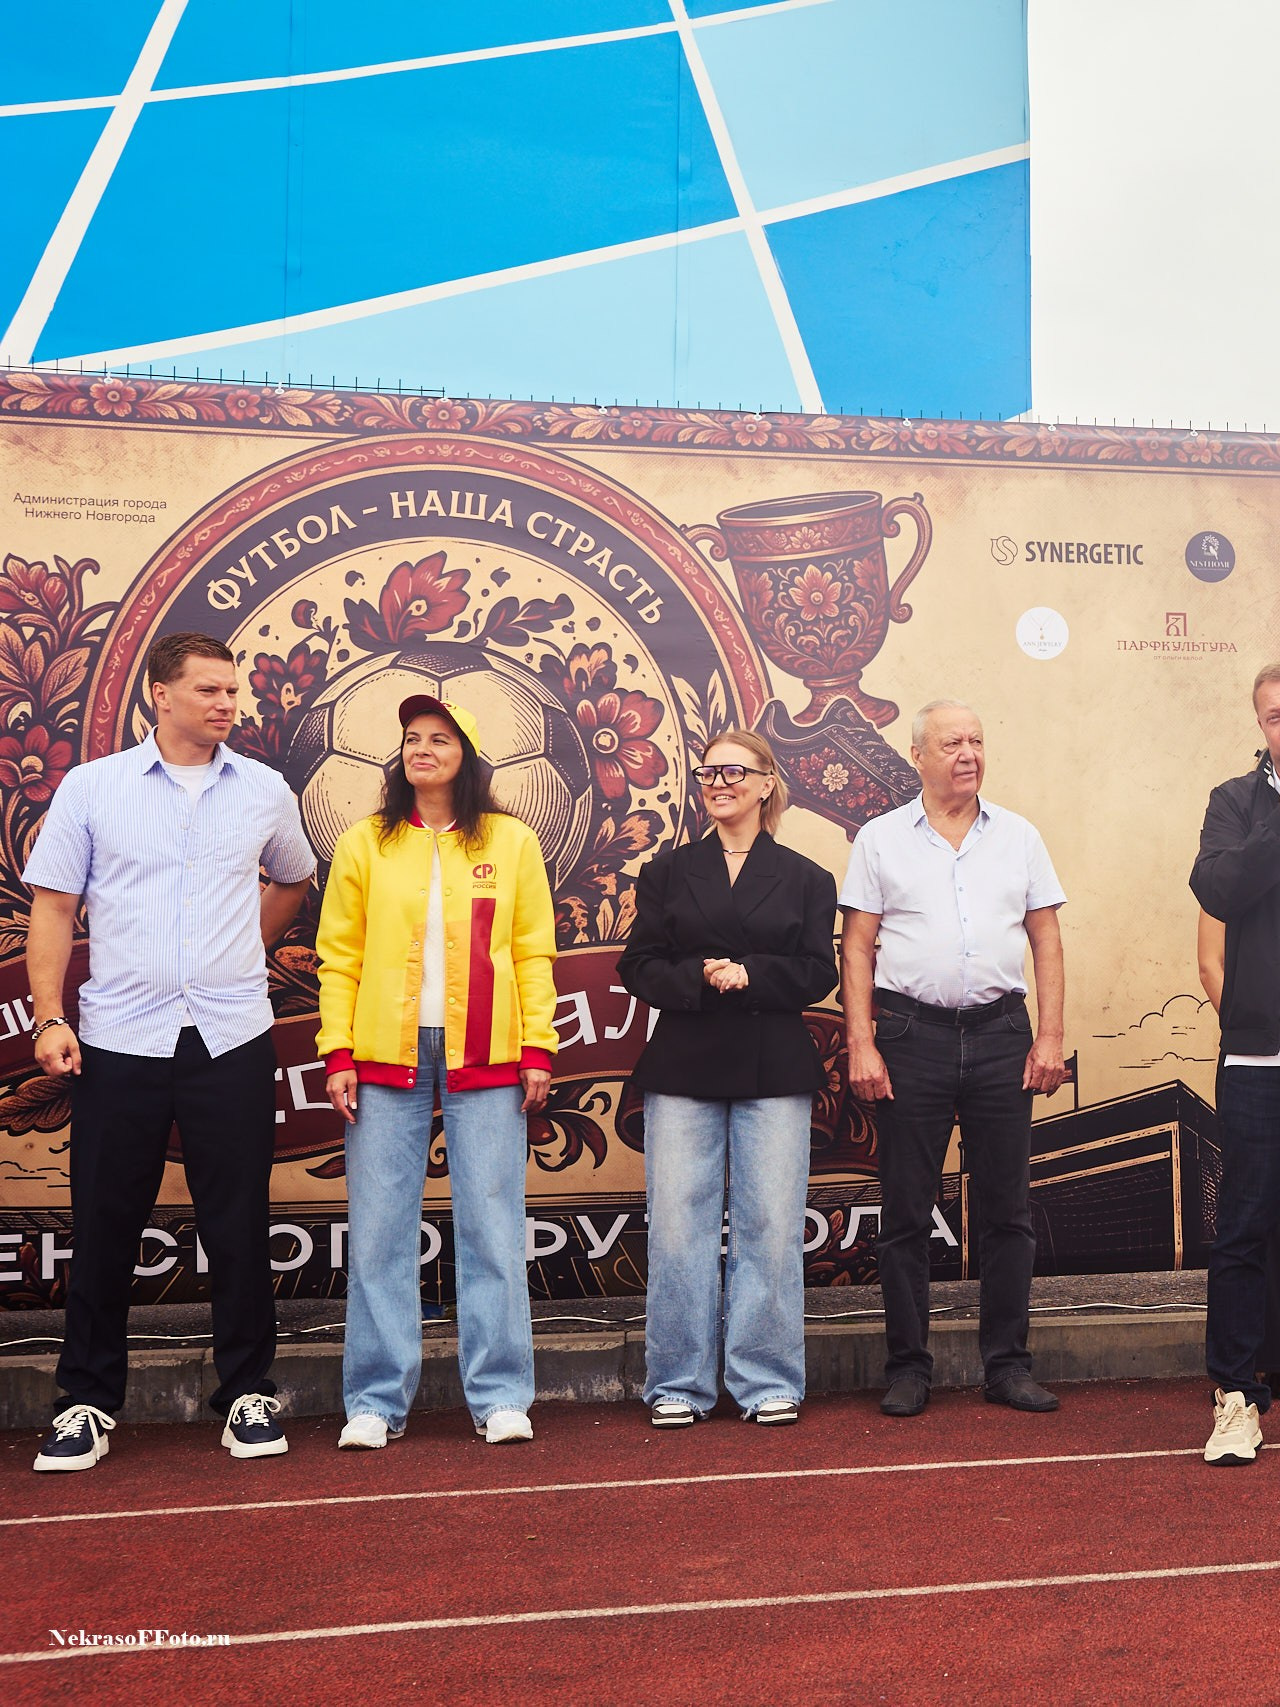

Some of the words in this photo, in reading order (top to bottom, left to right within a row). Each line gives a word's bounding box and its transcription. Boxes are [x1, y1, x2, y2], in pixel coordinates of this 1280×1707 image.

[13, 492, 119, 507] Администрация
[123, 499, 168, 510] города
[25, 507, 82, 520] Нижнего
[86, 510, 156, 524] Новгорода
[206, 505, 357, 611] ФУТБОЛ
[390, 489, 525, 528] НАША
[527, 511, 666, 625] СТРАСТЬ
[1025, 541, 1144, 565] SYNERGETIC
[1117, 640, 1238, 653] ПАРФКУЛЬТУРА
